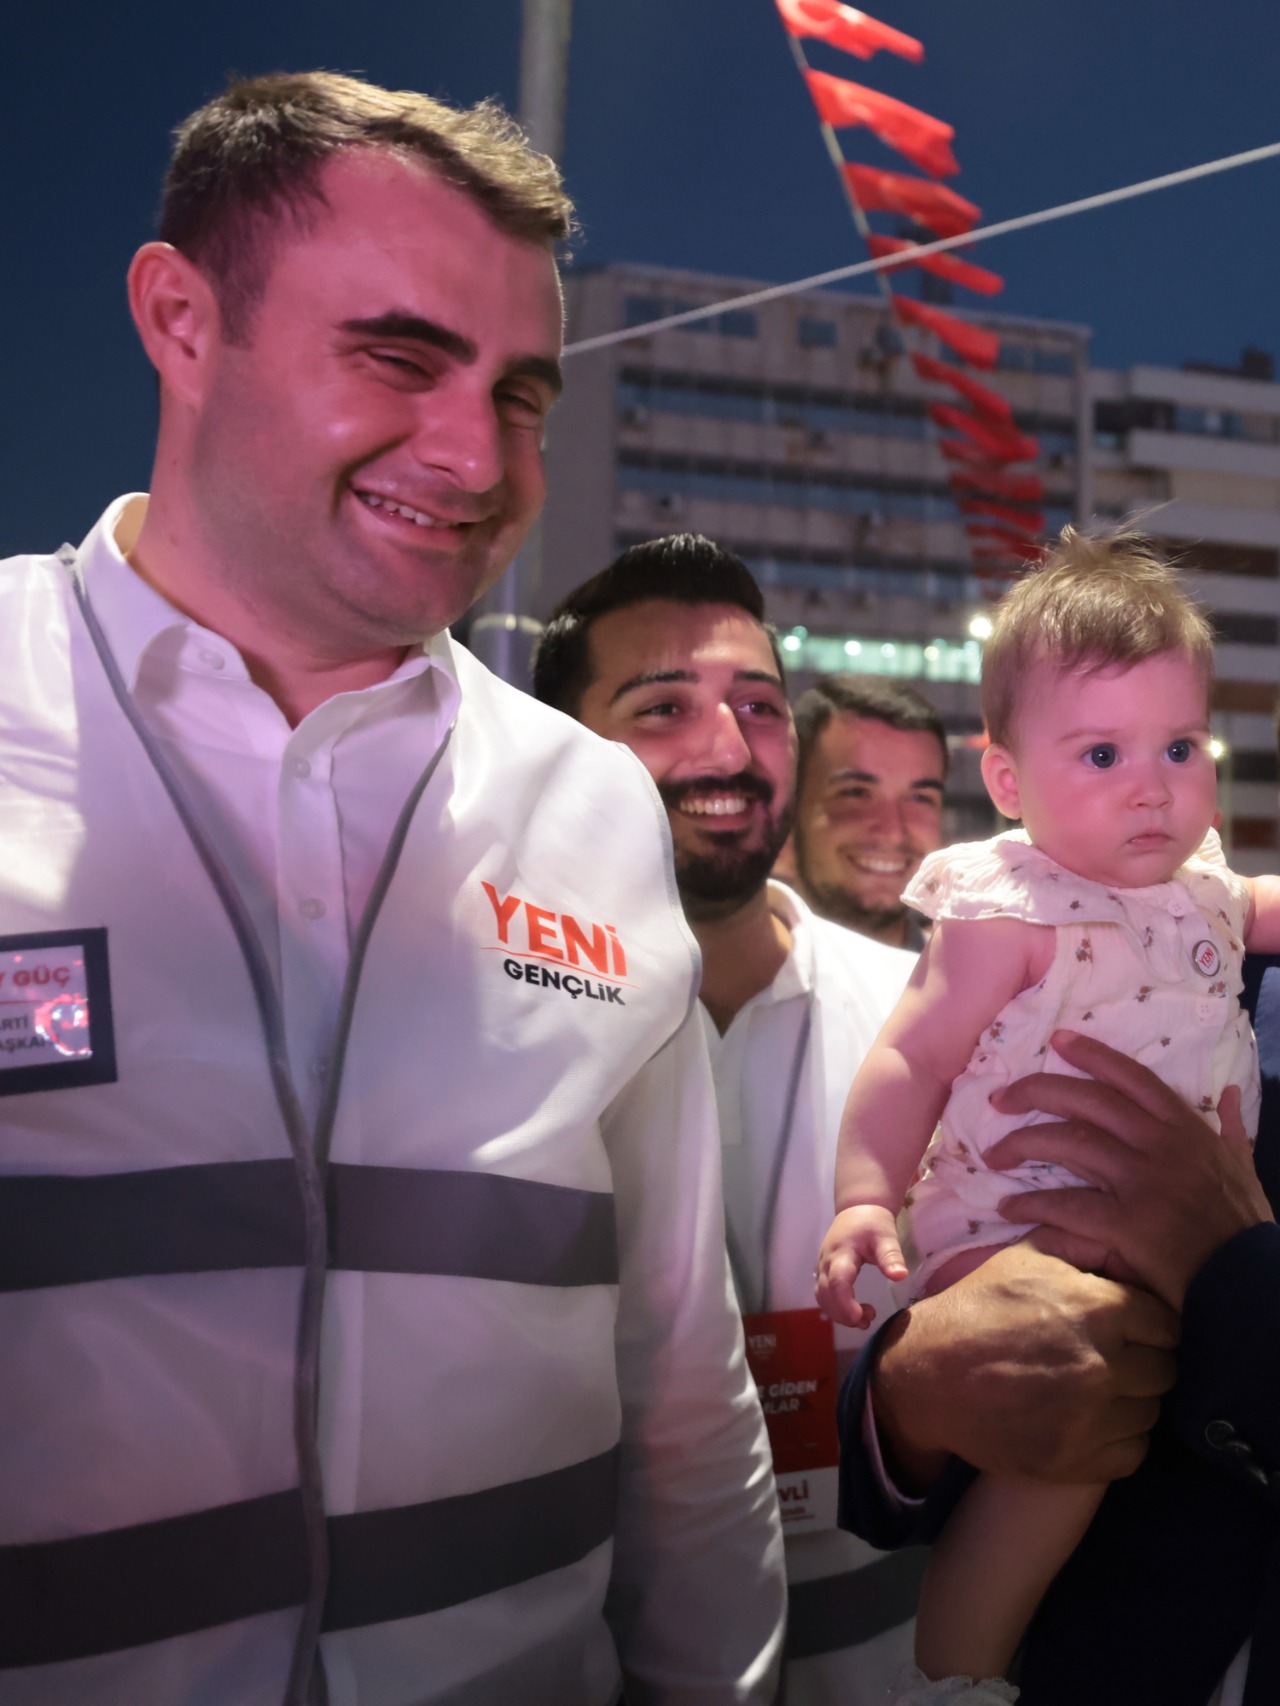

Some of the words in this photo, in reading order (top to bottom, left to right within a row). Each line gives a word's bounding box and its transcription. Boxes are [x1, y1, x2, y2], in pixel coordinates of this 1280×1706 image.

[481, 881, 627, 976] YENİ
[12, 965, 71, 987] GÜÇ
[503, 958, 626, 1006] GENÇLİK
[0, 1014, 28, 1031] RTİ
[769, 1379, 817, 1397] GİDEN
[779, 1480, 808, 1501] VLİ
